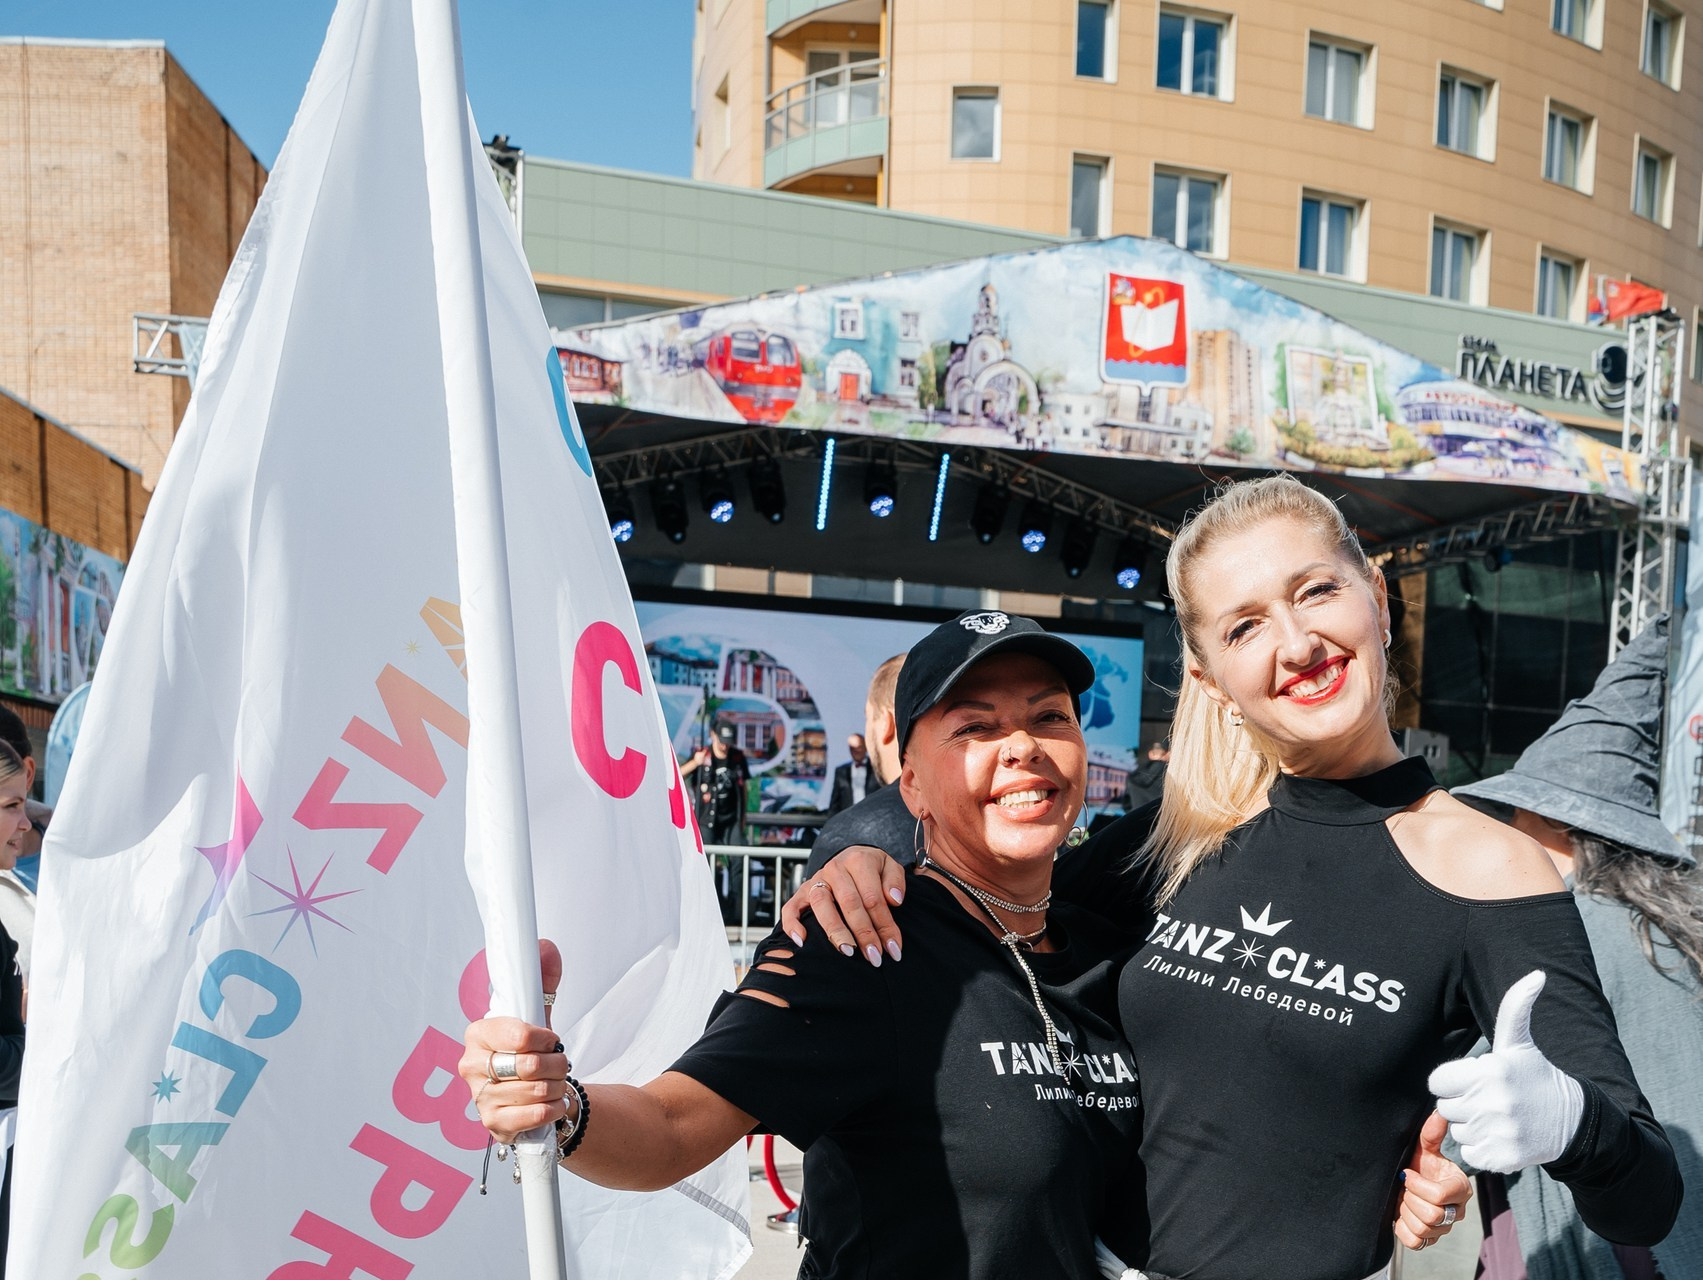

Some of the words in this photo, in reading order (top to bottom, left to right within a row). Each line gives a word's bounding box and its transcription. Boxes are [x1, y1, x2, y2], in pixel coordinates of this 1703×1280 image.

[1456, 349, 1588, 402] ПЛАНЕТА
[1143, 954, 1216, 988] Лилии
[1222, 976, 1354, 1027] Лебедевой
[1144, 912, 1236, 964] TANZ
[1266, 946, 1405, 1013] CLASS
[1076, 1091, 1140, 1112] ебедево
